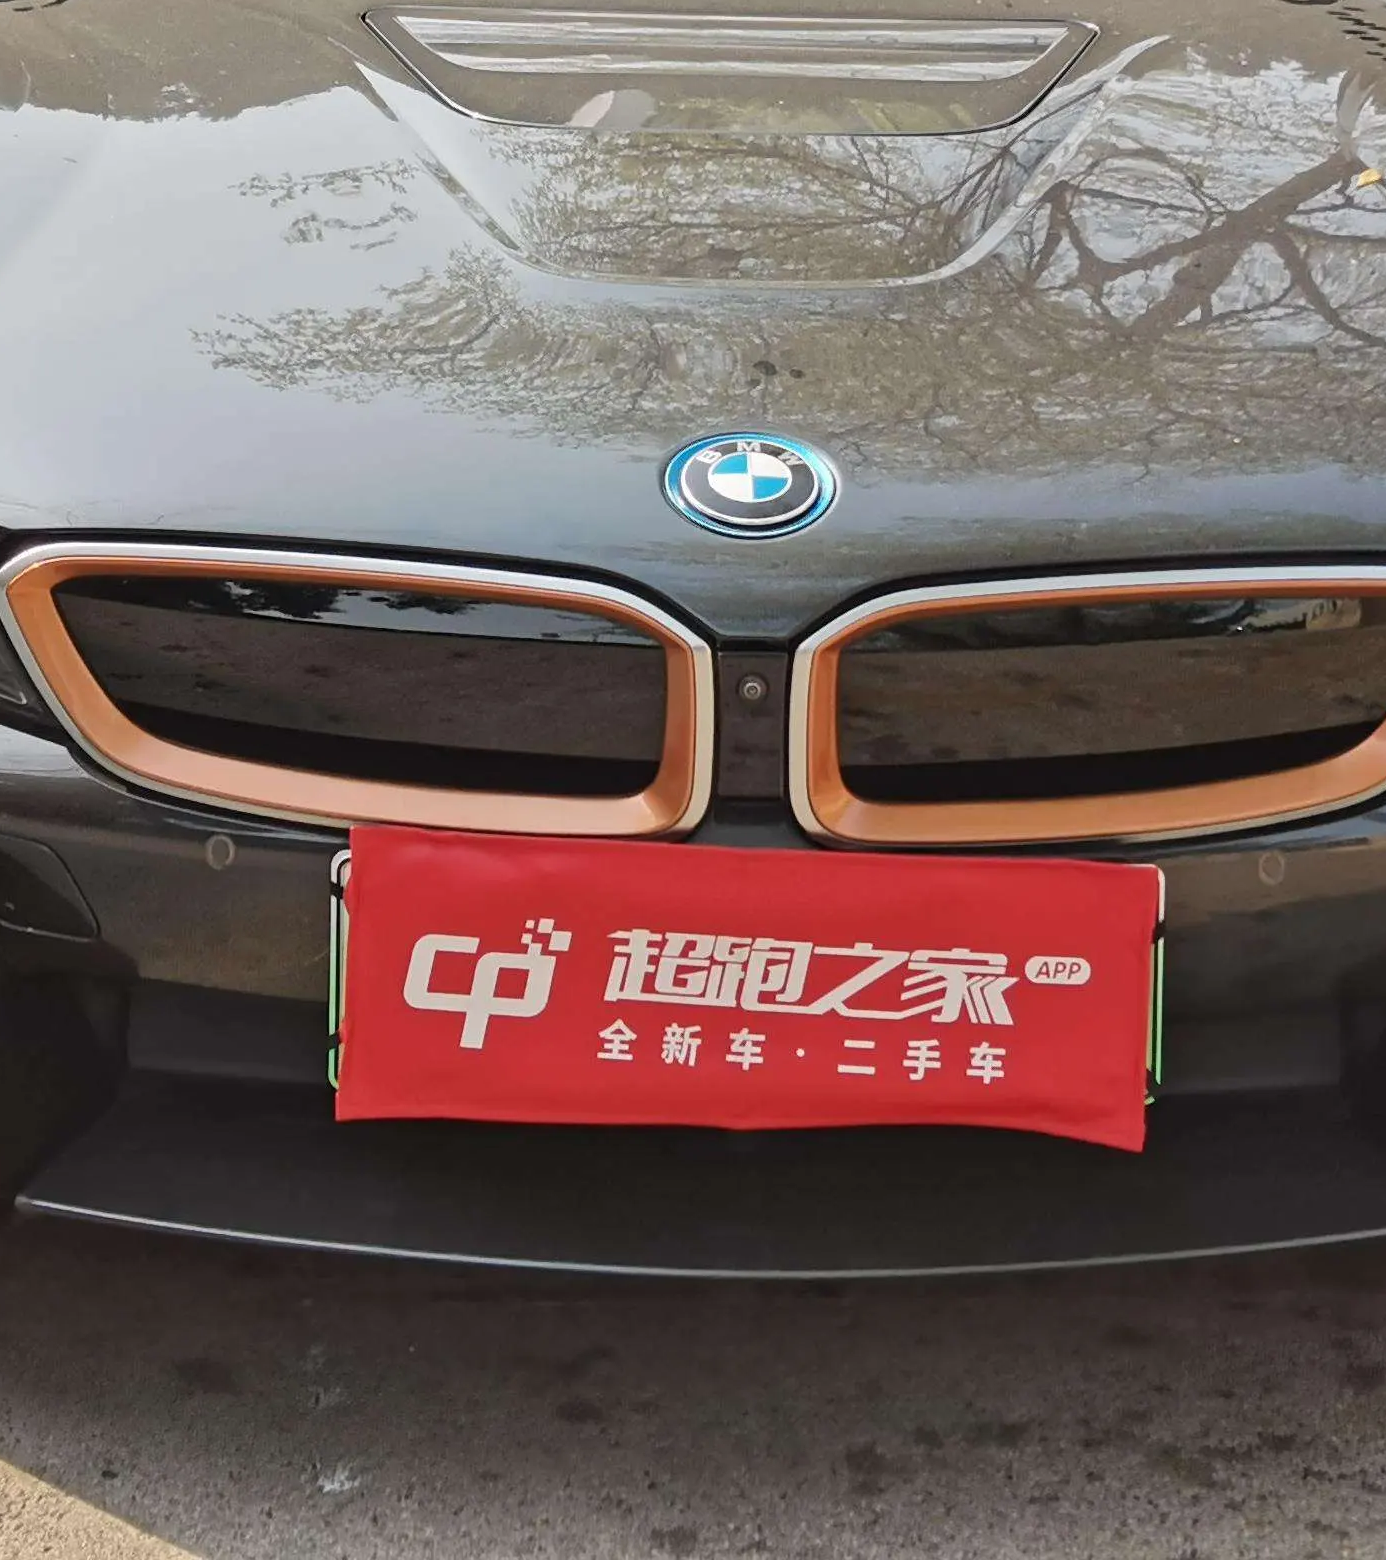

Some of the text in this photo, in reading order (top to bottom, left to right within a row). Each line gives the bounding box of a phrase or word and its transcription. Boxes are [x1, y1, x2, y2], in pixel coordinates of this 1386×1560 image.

[694, 440, 807, 466] BMW
[604, 928, 1083, 1026] 超跑之家 APP
